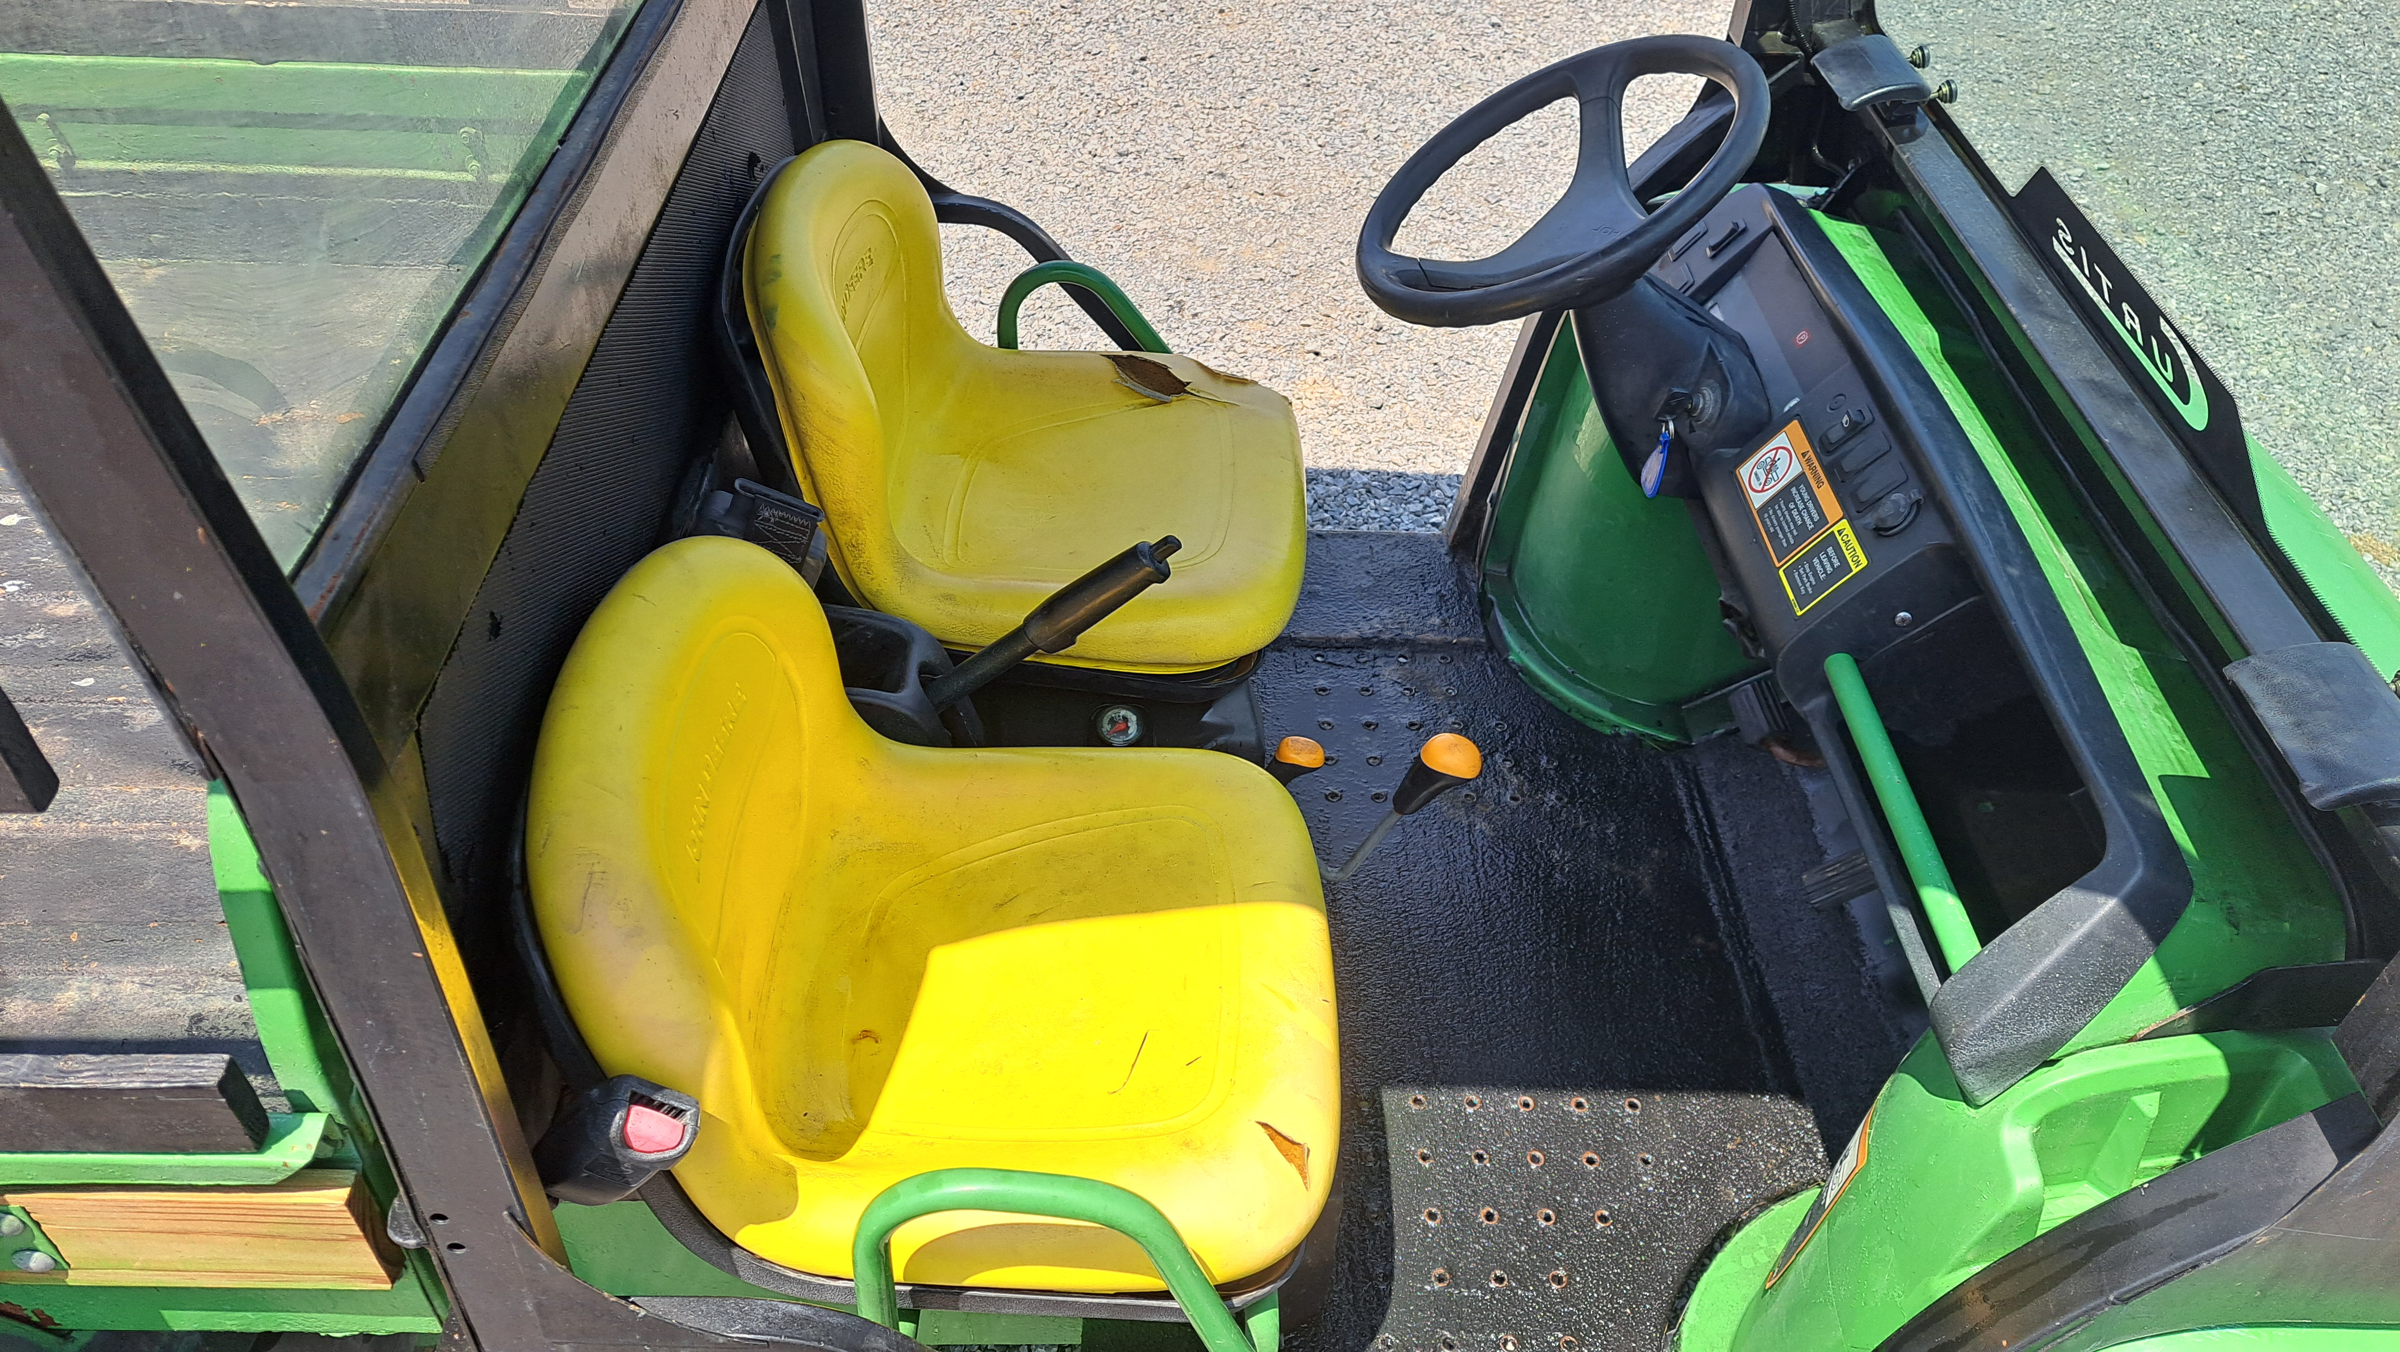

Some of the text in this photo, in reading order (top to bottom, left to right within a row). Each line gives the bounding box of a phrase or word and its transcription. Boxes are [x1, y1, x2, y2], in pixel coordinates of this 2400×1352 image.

[1804, 455, 1825, 490] WARNING
[1788, 502, 1803, 526] OF DEATH
[1790, 486, 1815, 531] INCREASE CHANCE
[1799, 483, 1820, 522] YOUNG DRIVERS
[1819, 551, 1834, 575] LEAVING
[1826, 546, 1841, 569] BEFORE
[1840, 533, 1864, 570] CAUTION
